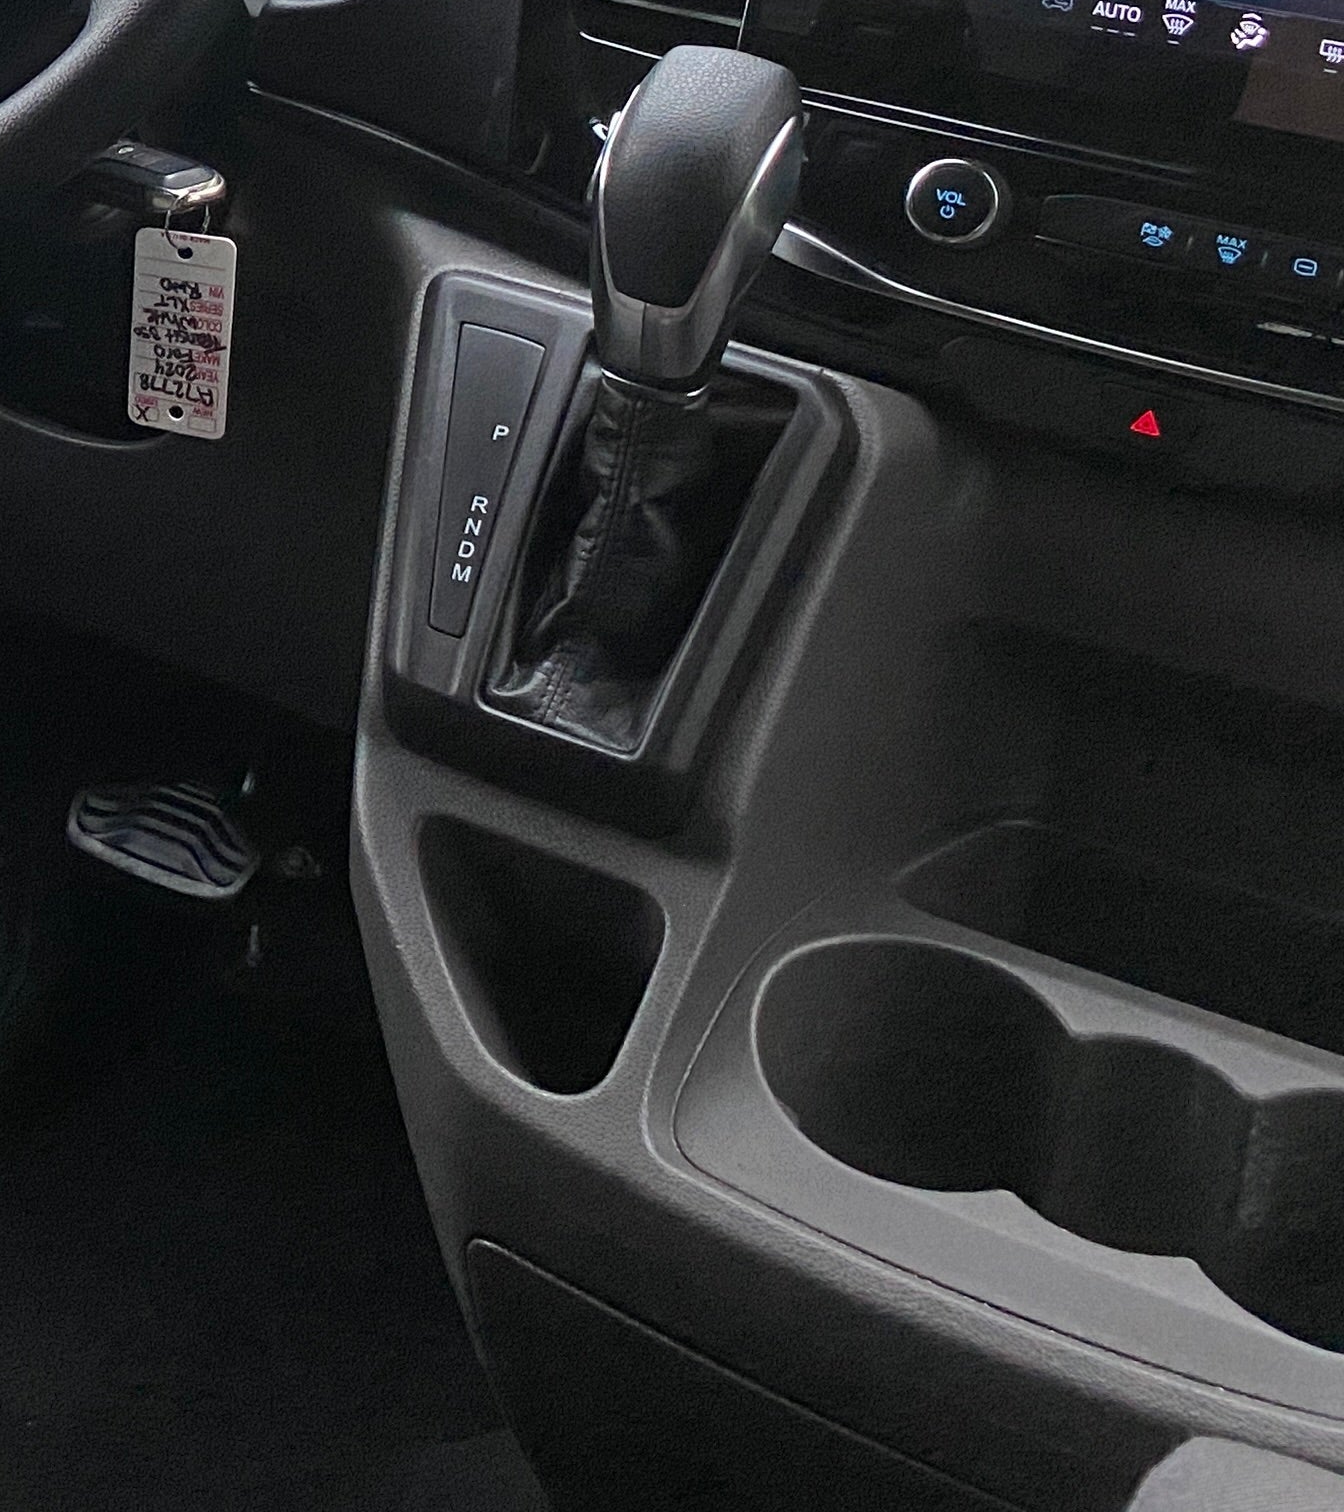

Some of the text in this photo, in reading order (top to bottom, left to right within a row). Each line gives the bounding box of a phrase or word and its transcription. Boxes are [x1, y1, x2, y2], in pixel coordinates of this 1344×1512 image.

[1092, 0, 1142, 24] AUTO
[936, 188, 967, 206] VOL
[1216, 234, 1248, 250] MAX
[208, 286, 225, 299] VIN
[153, 294, 190, 313] XLT
[492, 424, 510, 440] P
[470, 495, 489, 514] R
[464, 518, 482, 536] N
[458, 540, 475, 558] D
[451, 563, 472, 582] M
